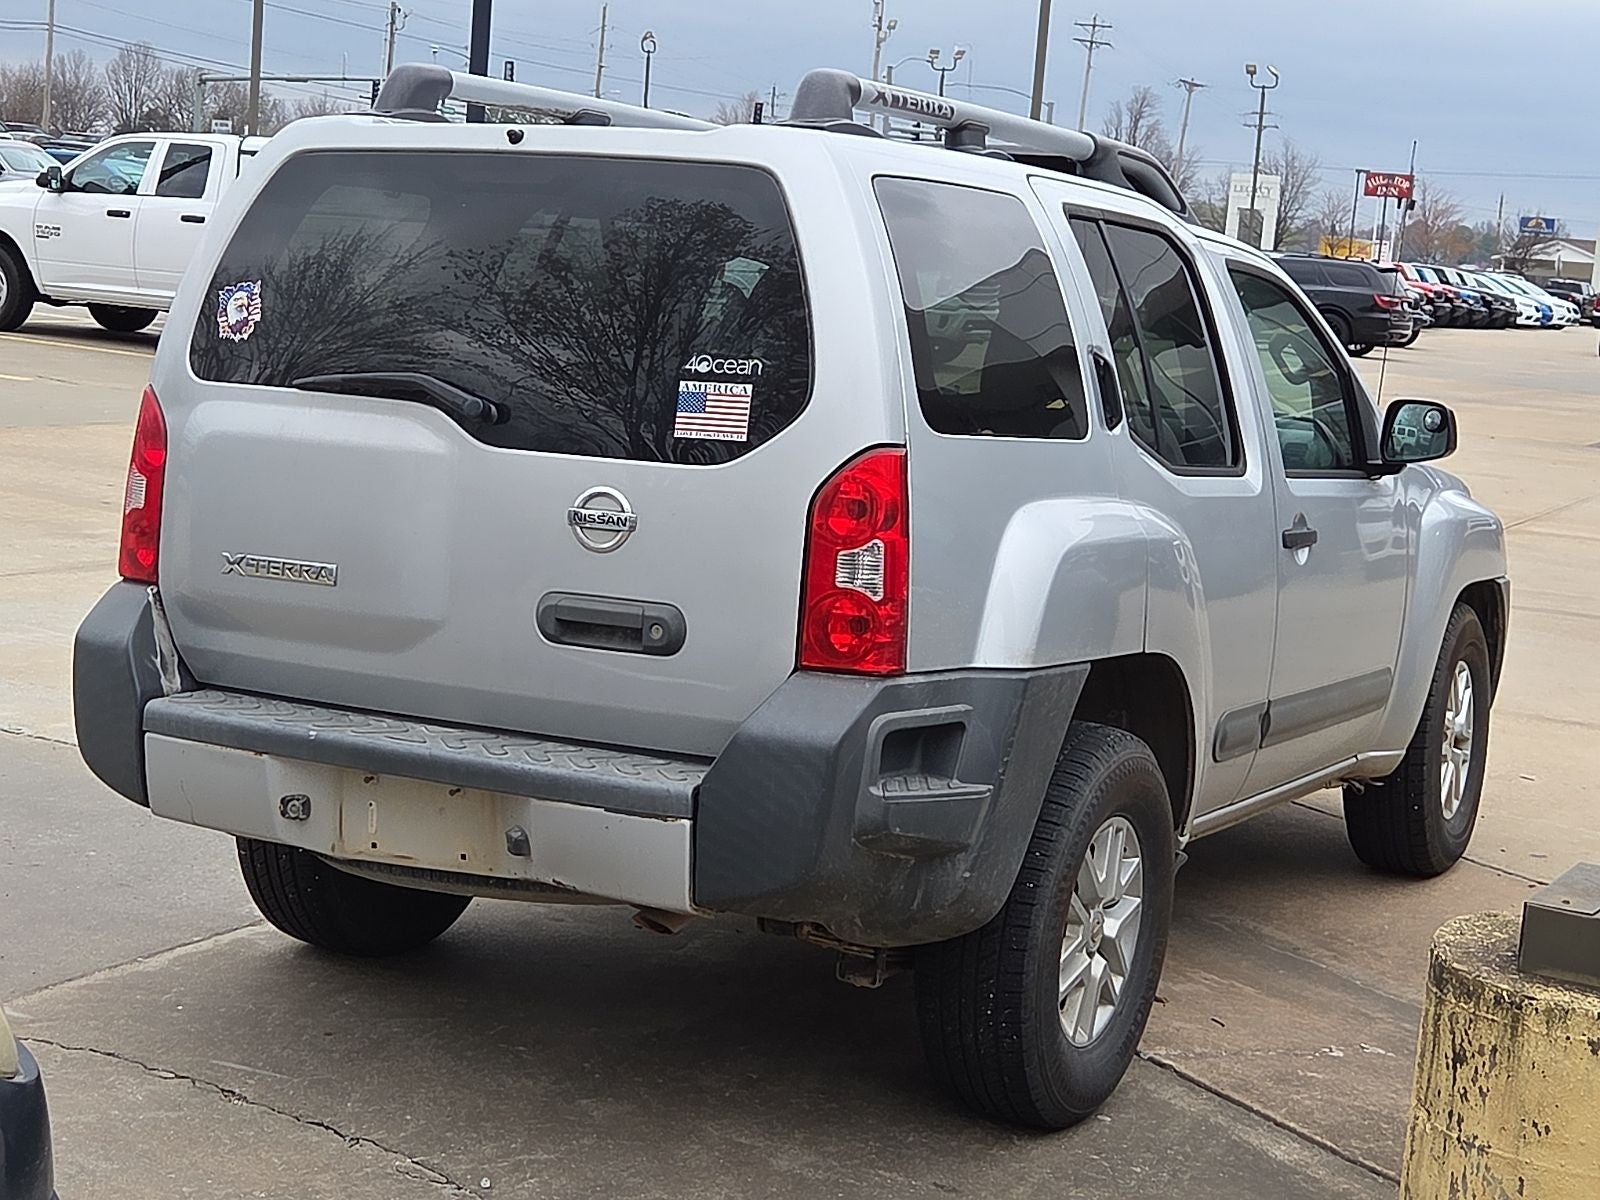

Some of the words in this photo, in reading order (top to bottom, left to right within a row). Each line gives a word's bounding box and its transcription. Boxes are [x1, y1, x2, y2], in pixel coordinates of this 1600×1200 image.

[870, 86, 955, 119] XTERRA
[682, 382, 748, 395] AMERICA
[573, 510, 628, 528] NISSAN
[221, 552, 337, 586] XTERRA
